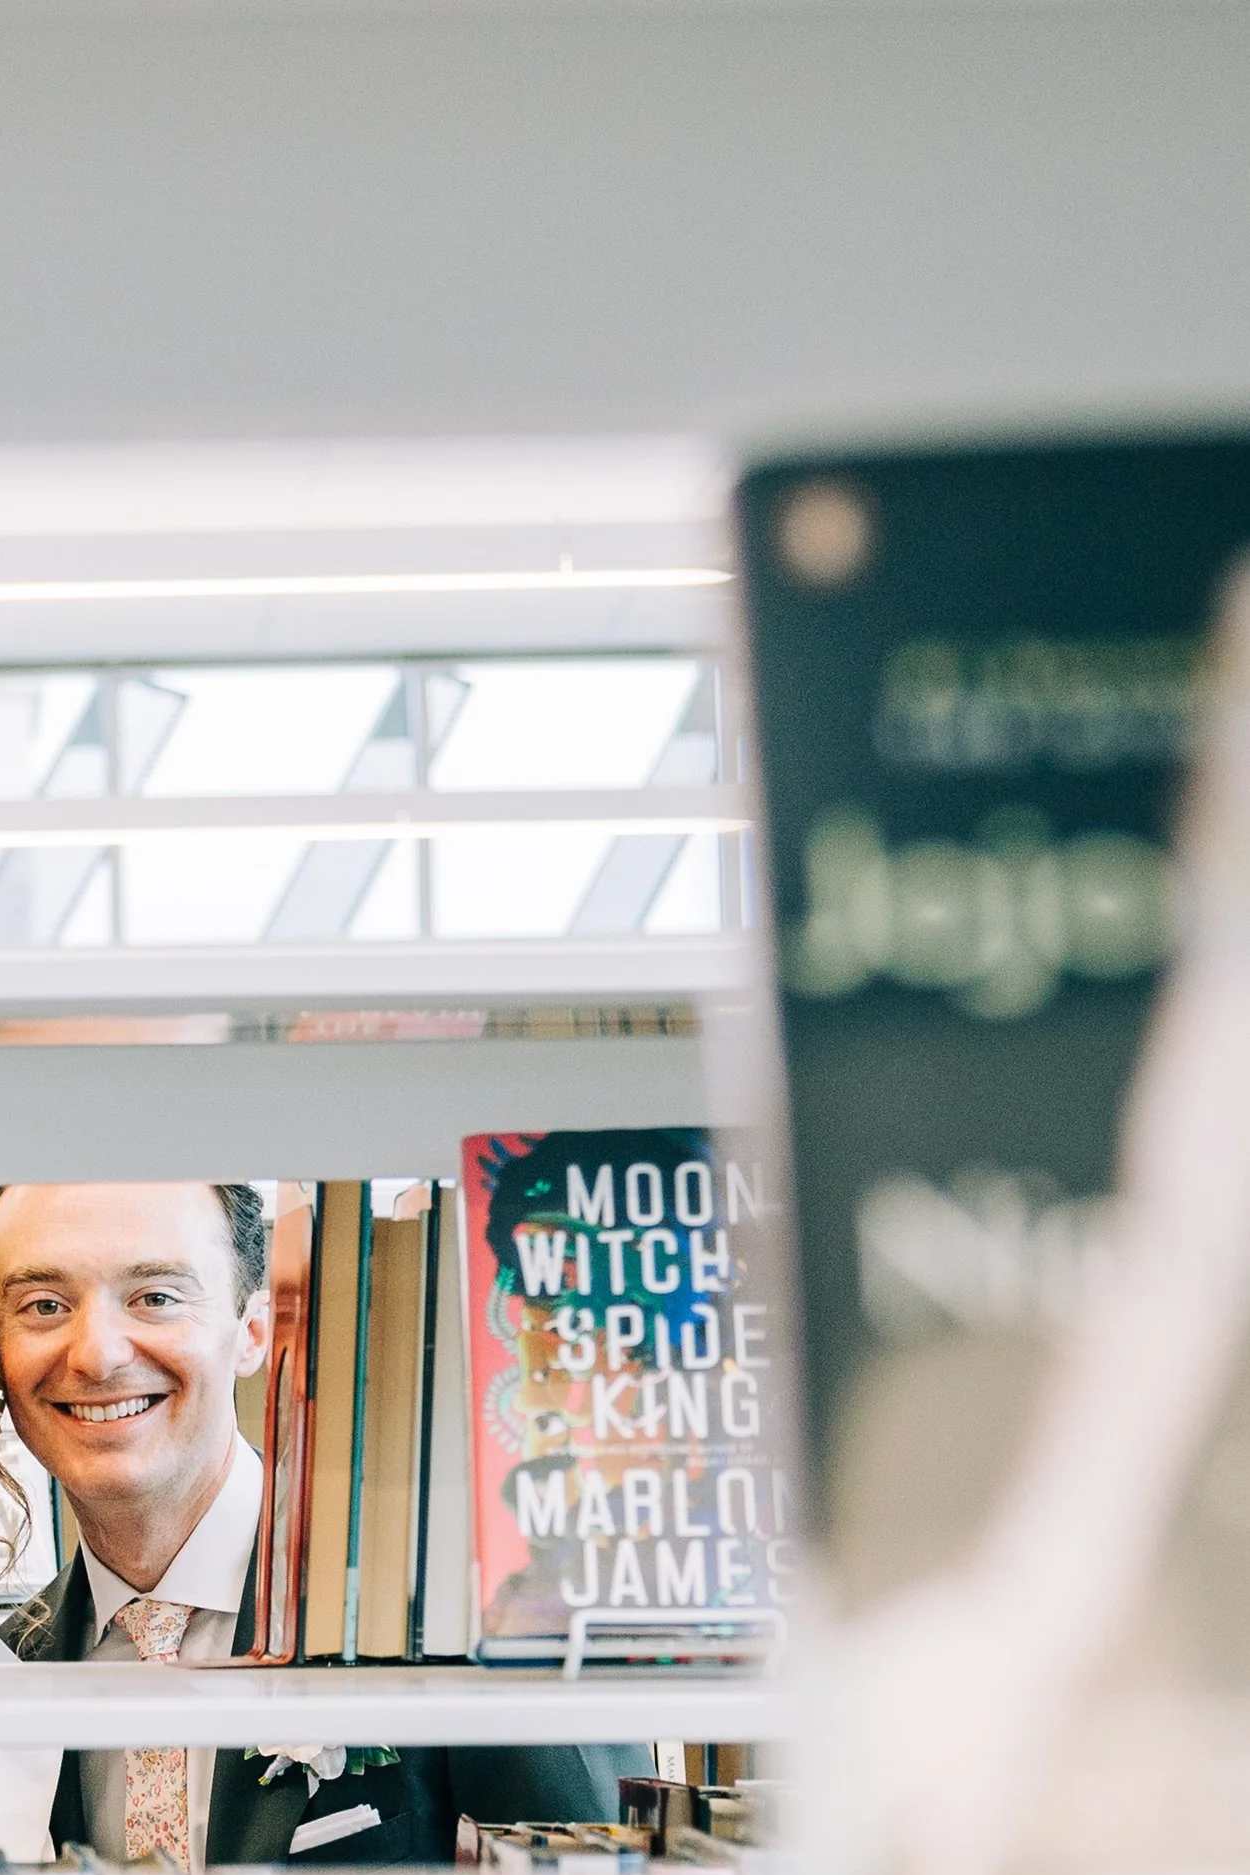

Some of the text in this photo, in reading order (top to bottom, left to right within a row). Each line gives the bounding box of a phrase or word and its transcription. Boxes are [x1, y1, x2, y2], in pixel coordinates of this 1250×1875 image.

[565, 1160, 764, 1229] MOON
[517, 1228, 730, 1297] WITCH
[590, 1370, 760, 1440] KING
